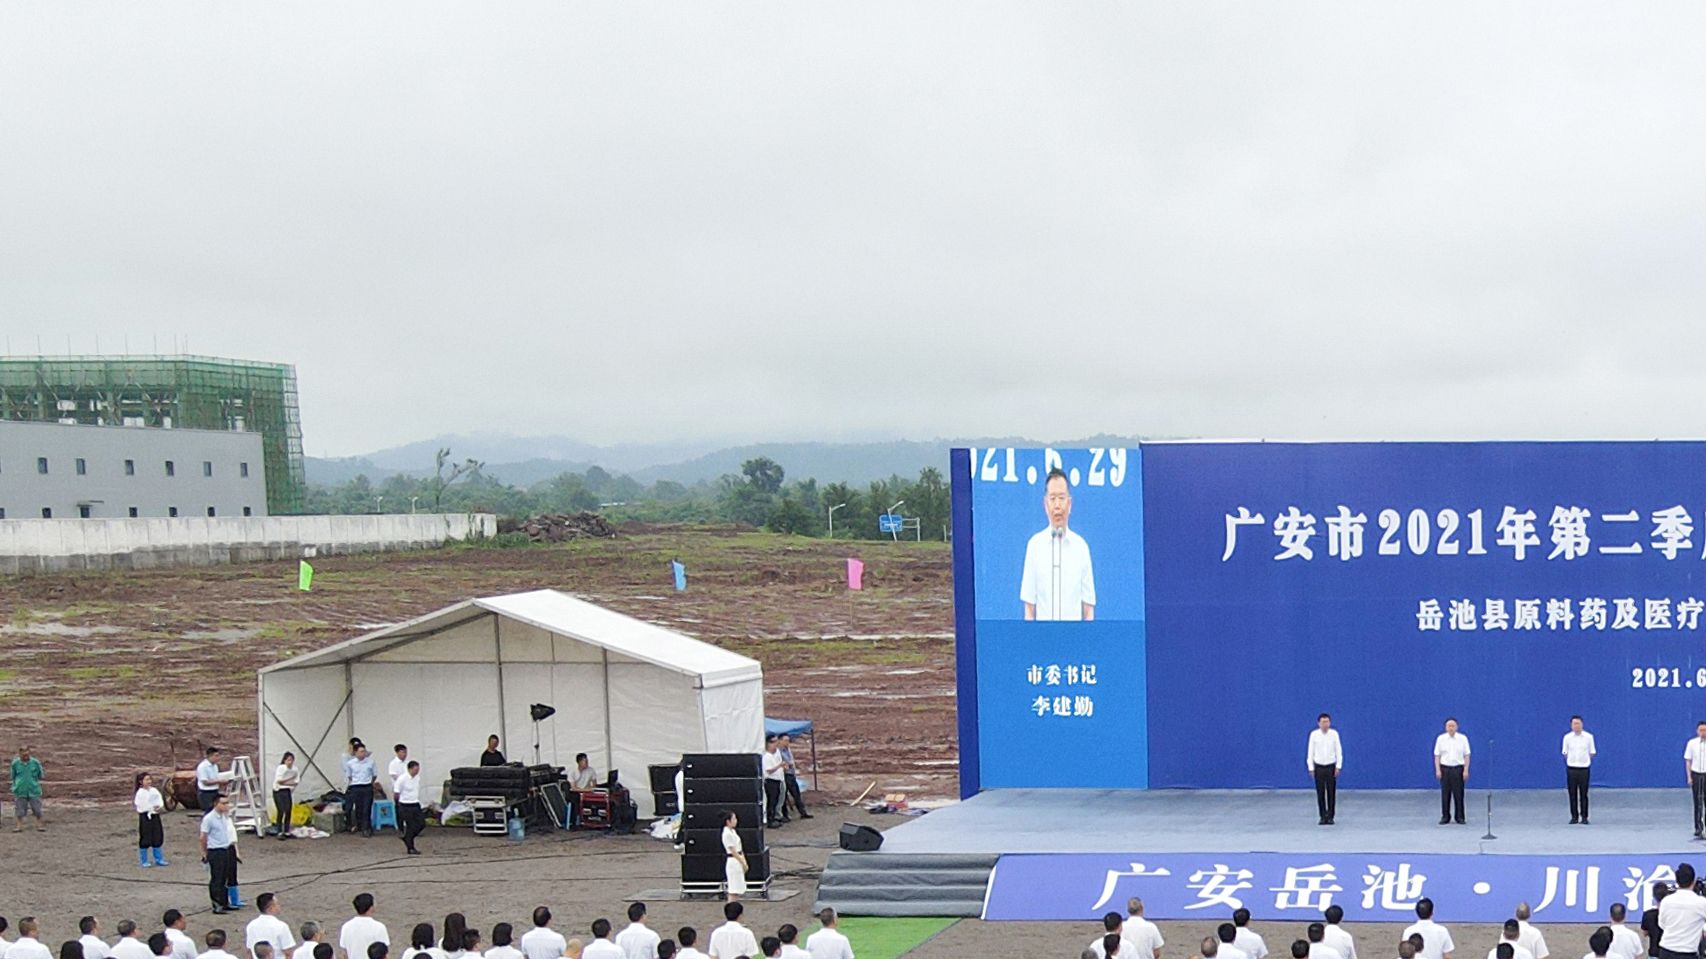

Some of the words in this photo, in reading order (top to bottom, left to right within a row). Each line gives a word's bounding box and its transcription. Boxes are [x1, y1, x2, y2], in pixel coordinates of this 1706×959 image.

[1026, 664, 1097, 685] 市委书记
[1031, 695, 1094, 717] 李建勤
